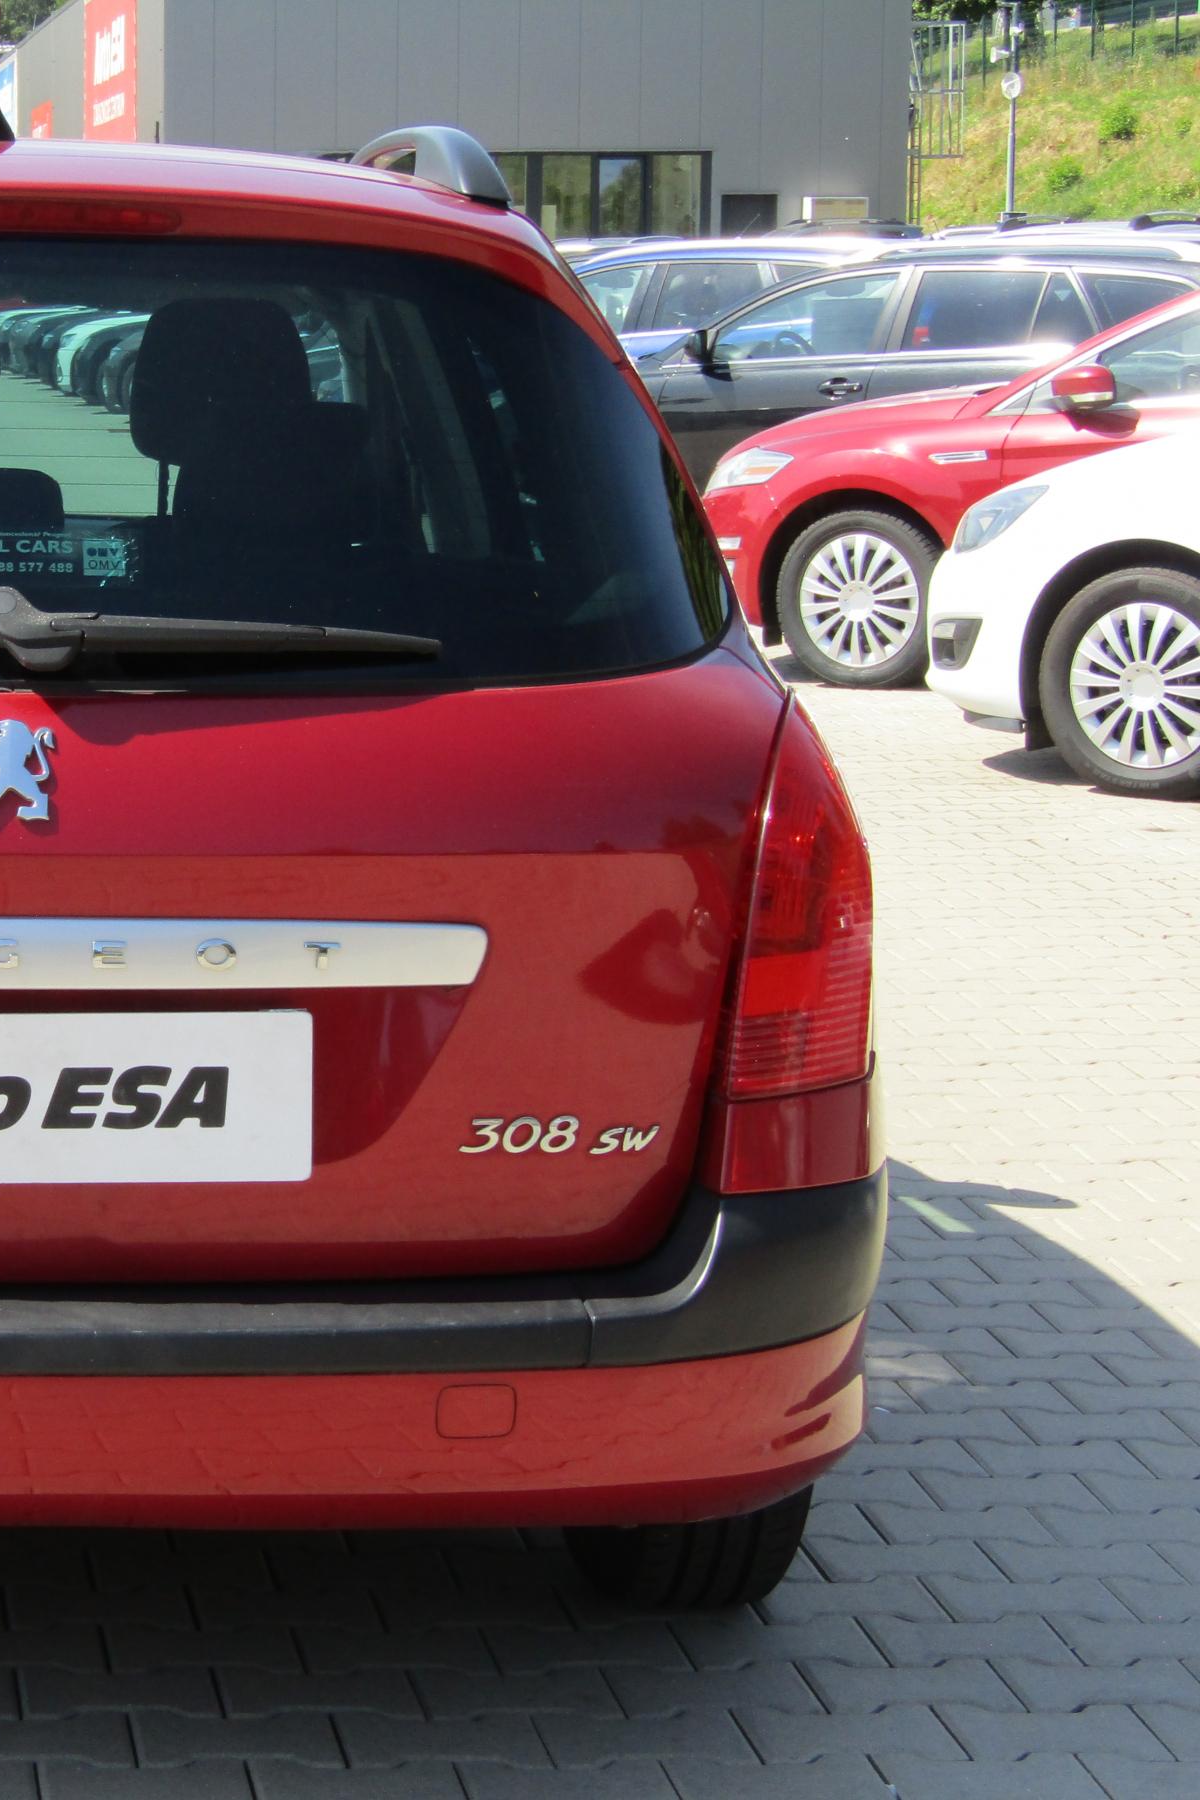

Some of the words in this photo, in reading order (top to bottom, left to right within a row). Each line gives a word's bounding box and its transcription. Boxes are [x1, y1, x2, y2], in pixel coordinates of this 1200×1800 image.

[15, 539, 74, 554] CARS
[18, 562, 44, 573] 577
[48, 562, 74, 573] 488
[88, 560, 120, 570] OMV
[41, 1065, 230, 1131] ESA
[459, 1115, 580, 1154] 308
